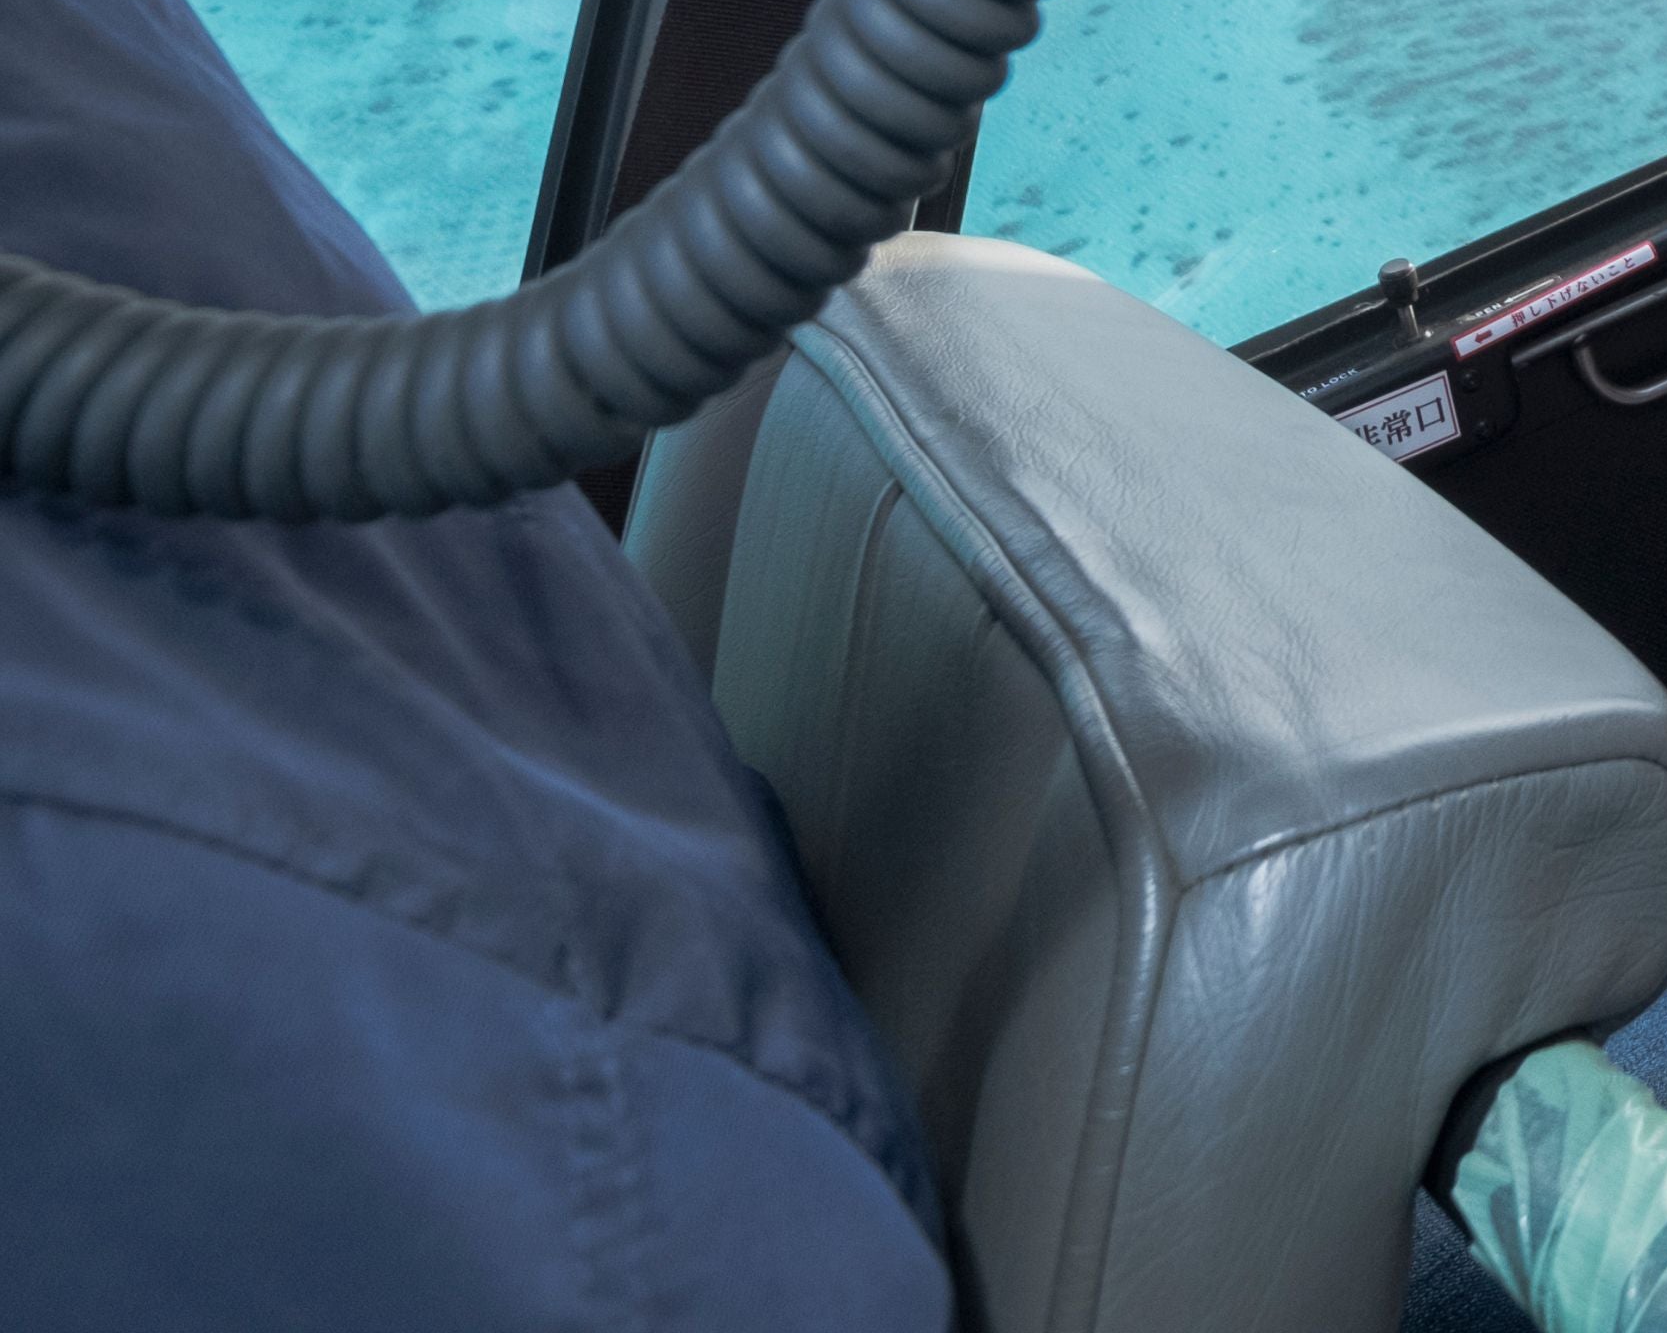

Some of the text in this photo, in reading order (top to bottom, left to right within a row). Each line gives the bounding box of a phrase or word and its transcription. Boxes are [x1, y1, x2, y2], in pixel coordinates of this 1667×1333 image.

[1511, 257, 1635, 327] 押し下げないこと
[1321, 368, 1358, 388] LOCK
